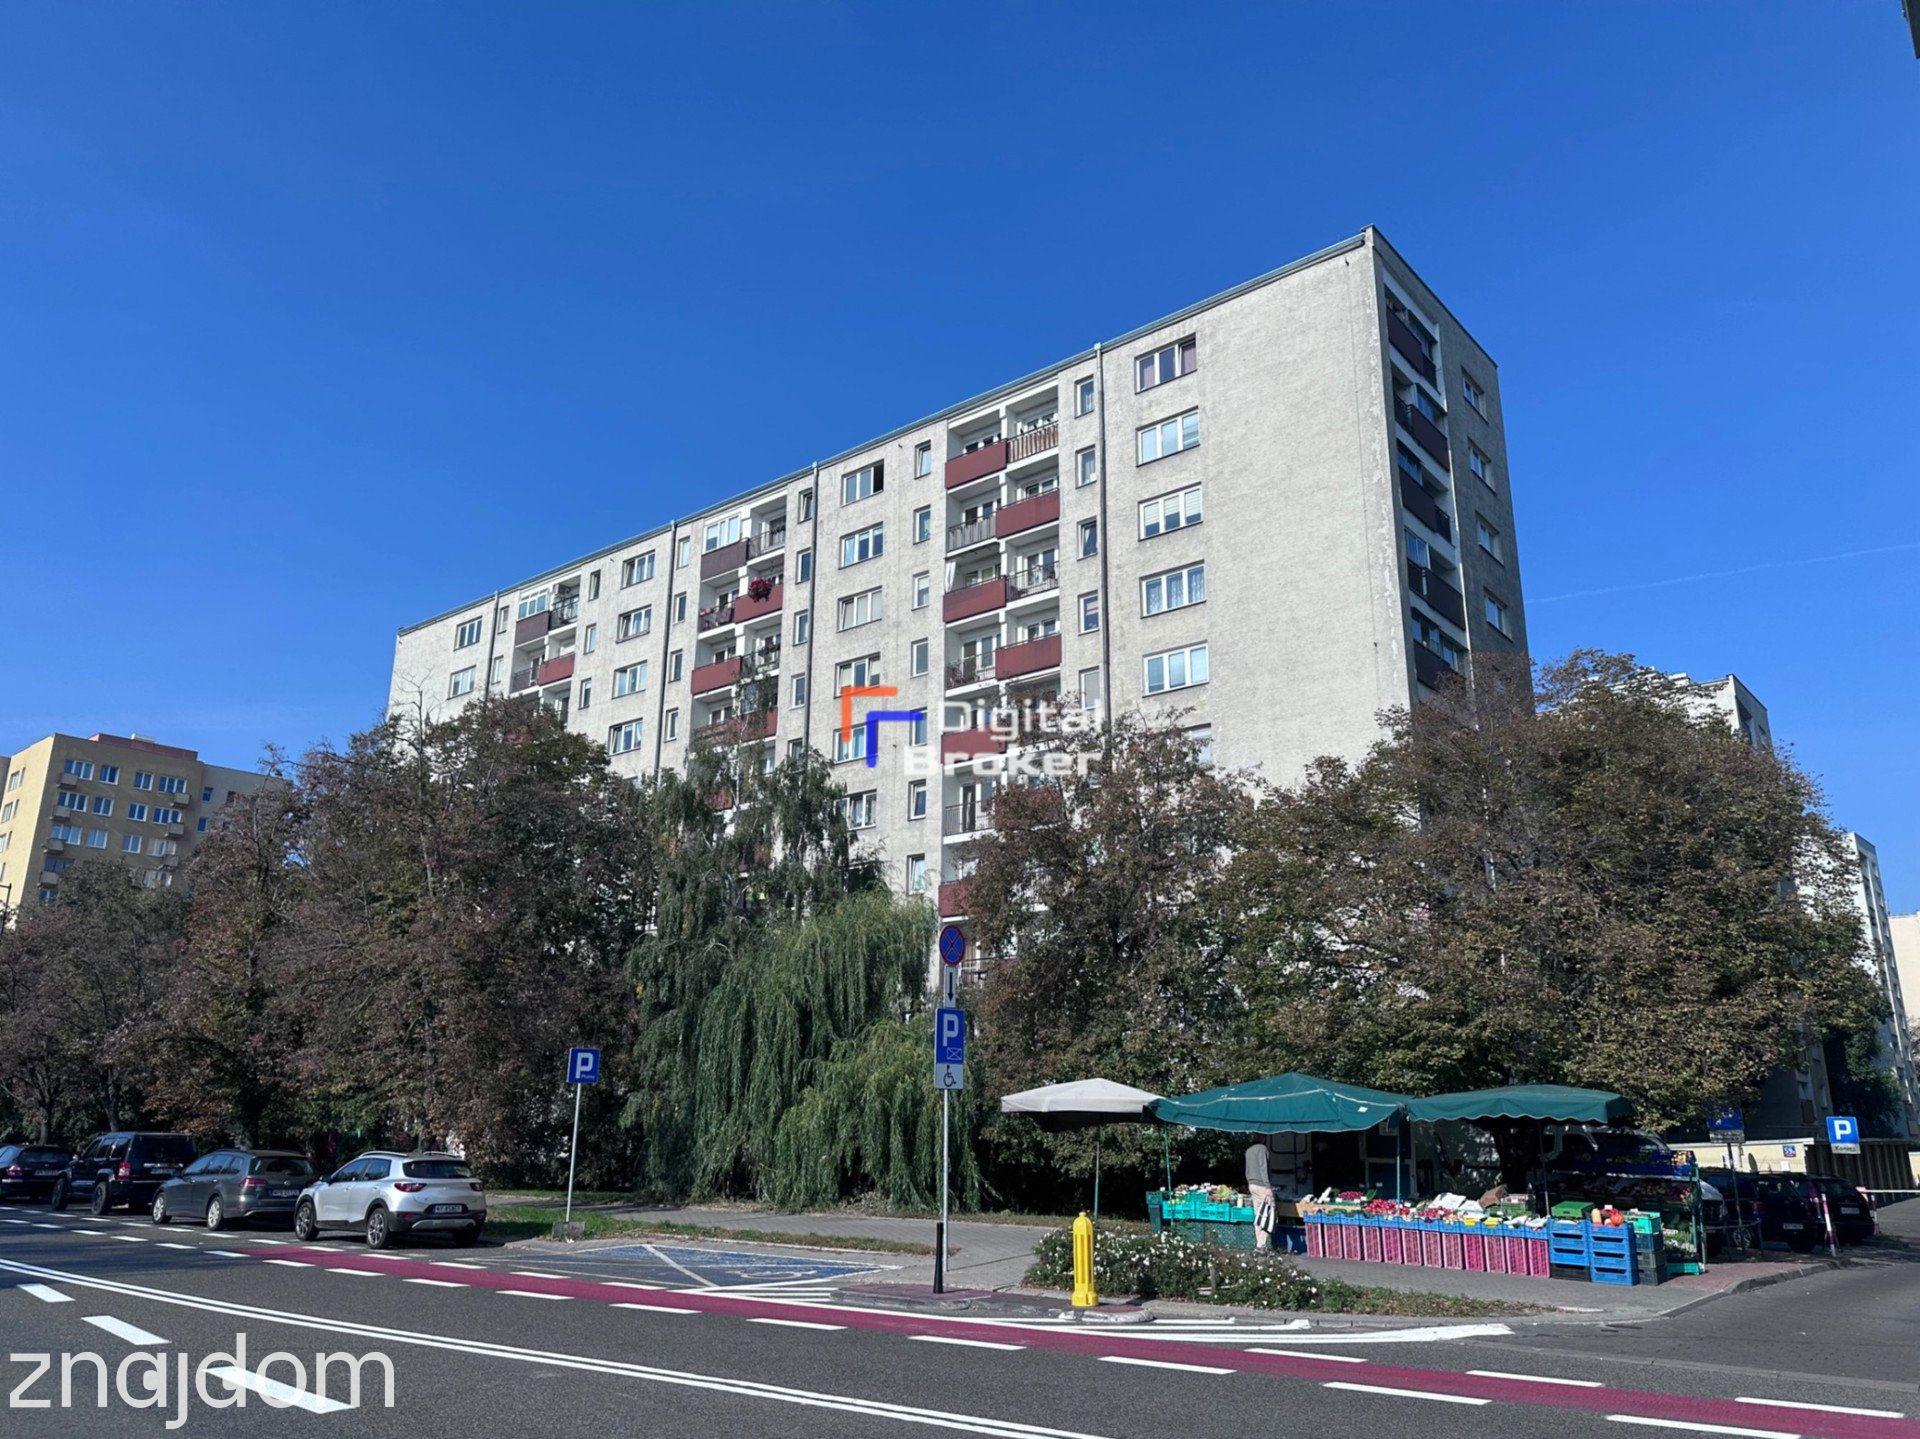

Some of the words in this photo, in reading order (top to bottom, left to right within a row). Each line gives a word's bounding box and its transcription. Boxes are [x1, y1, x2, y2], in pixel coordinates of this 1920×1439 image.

[943, 1013, 959, 1047] P
[575, 1052, 594, 1079] P
[1834, 1119, 1852, 1141] P
